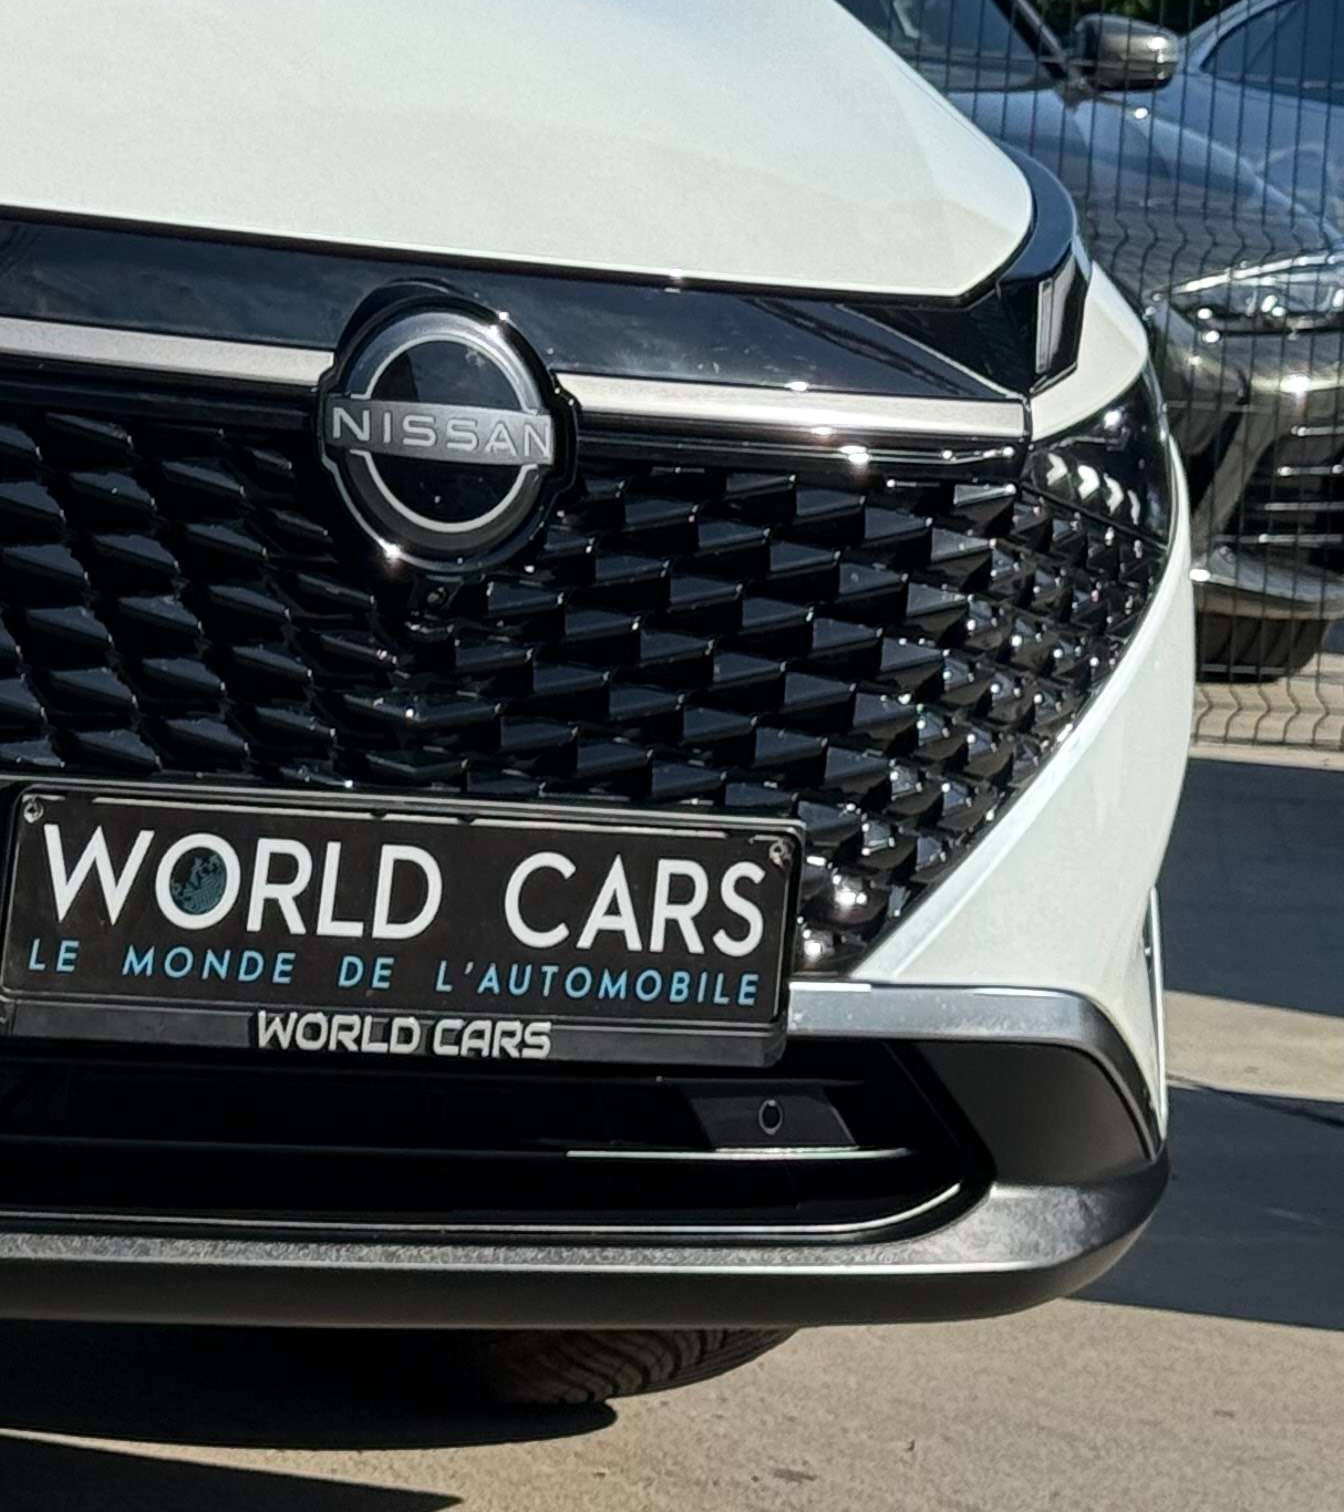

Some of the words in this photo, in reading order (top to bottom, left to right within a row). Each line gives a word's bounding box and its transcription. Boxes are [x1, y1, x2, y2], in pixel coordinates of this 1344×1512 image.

[332, 406, 552, 458] NISSAN
[43, 823, 443, 940] WORLD
[504, 850, 767, 958] CARS
[28, 938, 80, 974] LE
[121, 944, 297, 985] MONDE
[337, 955, 395, 989] DE
[435, 959, 760, 1007] L'AUTOMOBILE
[257, 1010, 422, 1055] WORLD
[432, 1018, 552, 1059] CARS
